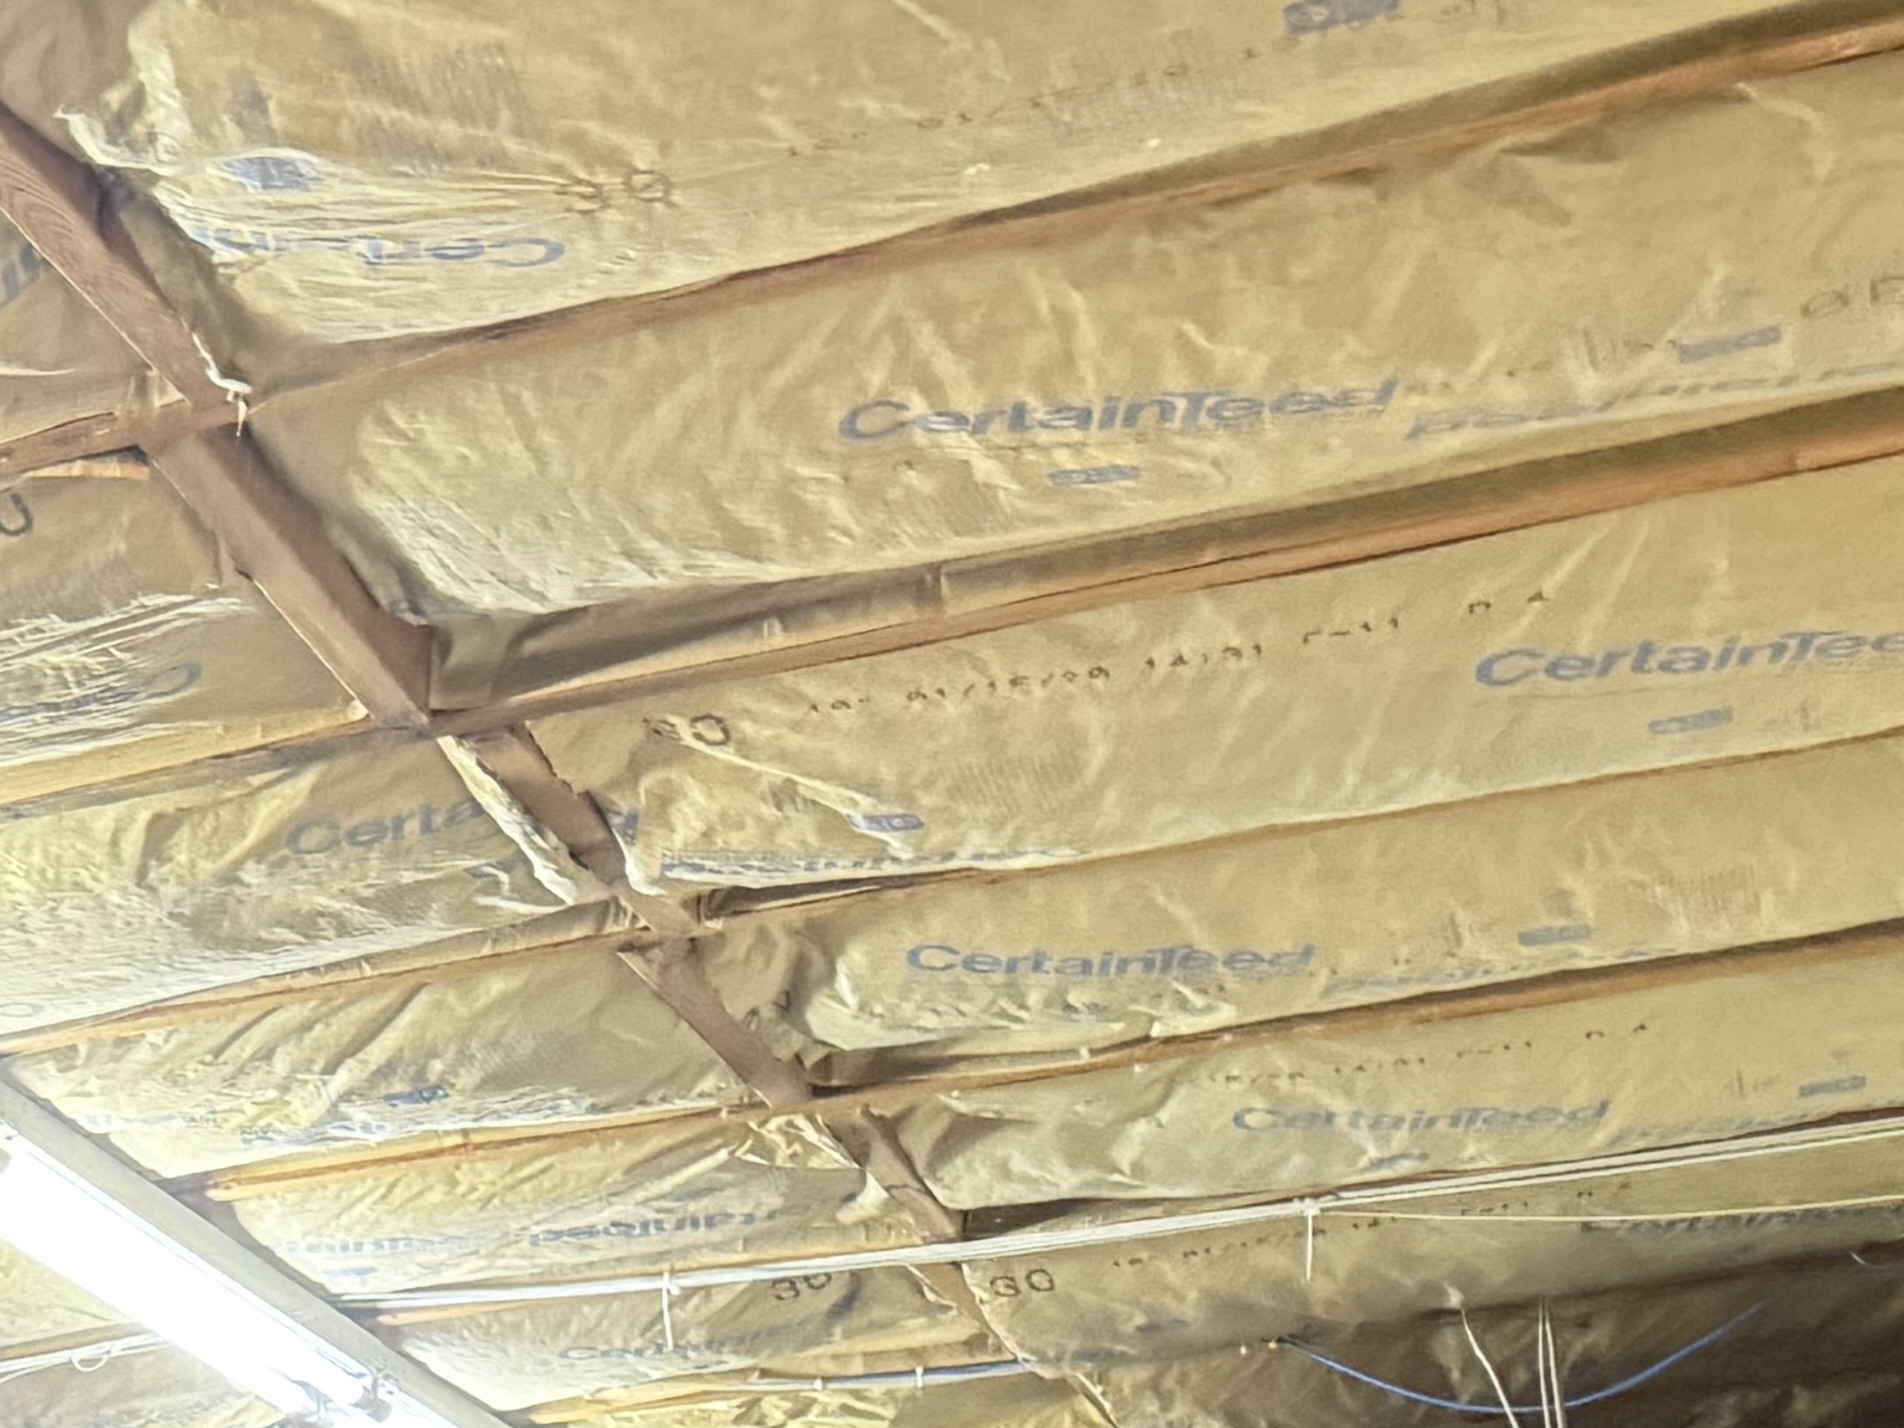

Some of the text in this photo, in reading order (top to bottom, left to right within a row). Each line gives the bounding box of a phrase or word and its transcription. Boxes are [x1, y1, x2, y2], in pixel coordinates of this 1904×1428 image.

[839, 376, 1399, 444] CertainTeed
[1474, 630, 1904, 690] CertainTee
[905, 941, 1316, 978] CertainTeed
[1231, 1098, 1613, 1134] CertainTeed
